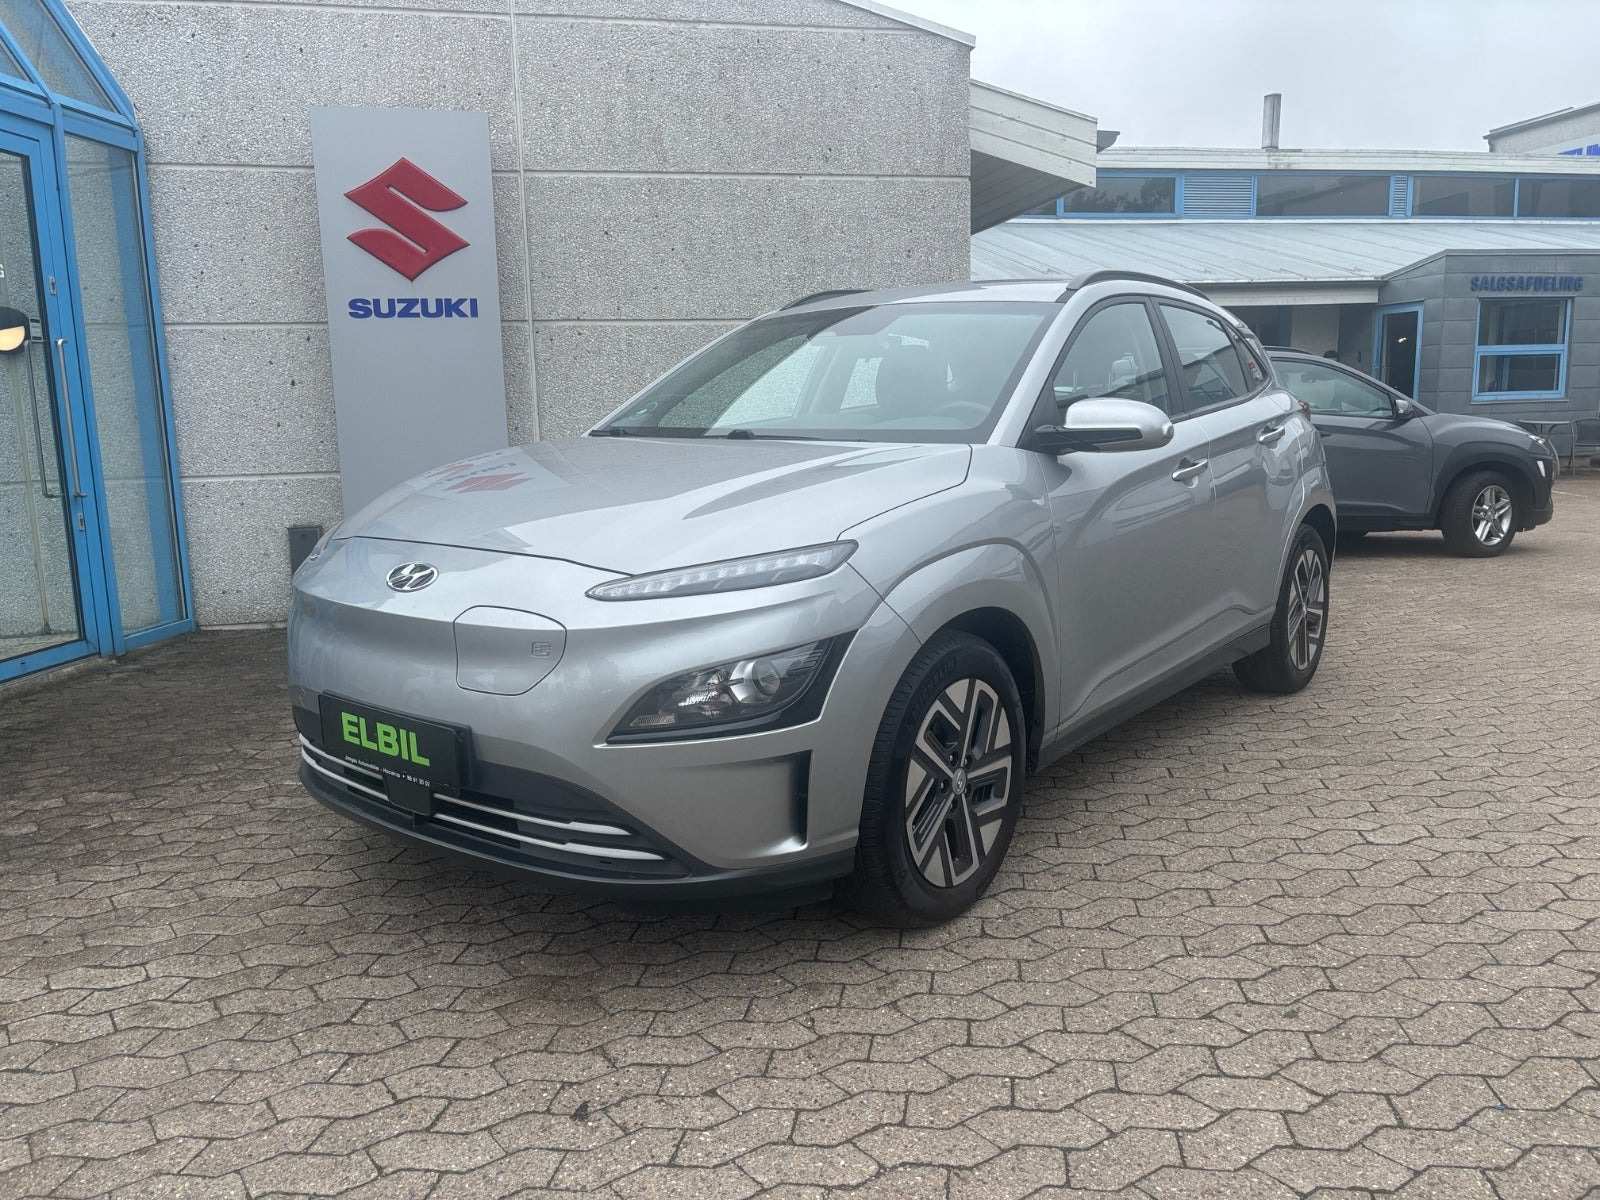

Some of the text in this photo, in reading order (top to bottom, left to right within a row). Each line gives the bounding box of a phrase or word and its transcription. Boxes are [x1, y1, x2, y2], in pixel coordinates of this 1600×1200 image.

[1470, 276, 1584, 292] SALGSAFDELING
[348, 298, 478, 318] SUZUKI
[341, 711, 430, 767] ELBIL
